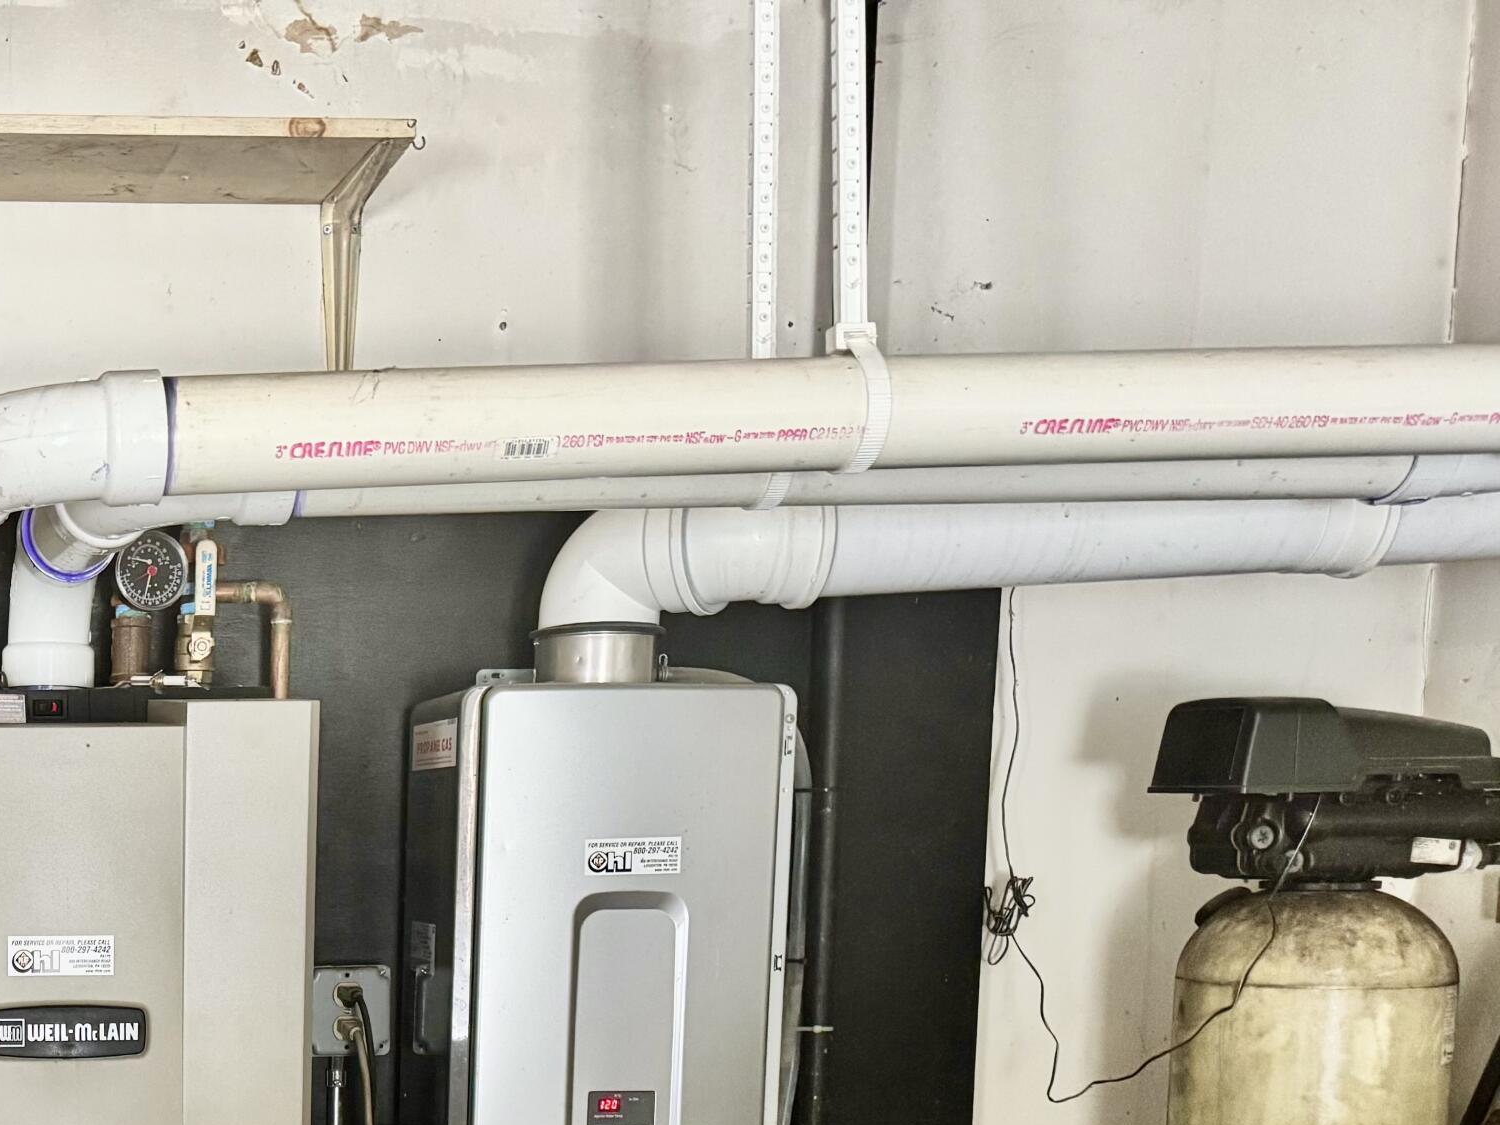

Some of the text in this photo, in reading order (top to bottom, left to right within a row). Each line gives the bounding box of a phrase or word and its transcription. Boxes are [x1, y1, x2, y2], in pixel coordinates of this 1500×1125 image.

[384, 440, 406, 455] PVC
[407, 440, 434, 454] DWV
[562, 434, 584, 448] 260
[586, 433, 605, 448] PSI
[633, 846, 679, 855] 800-297-4242
[61, 945, 112, 954] 800-297-4242
[600, 1099, 618, 1110] 120
